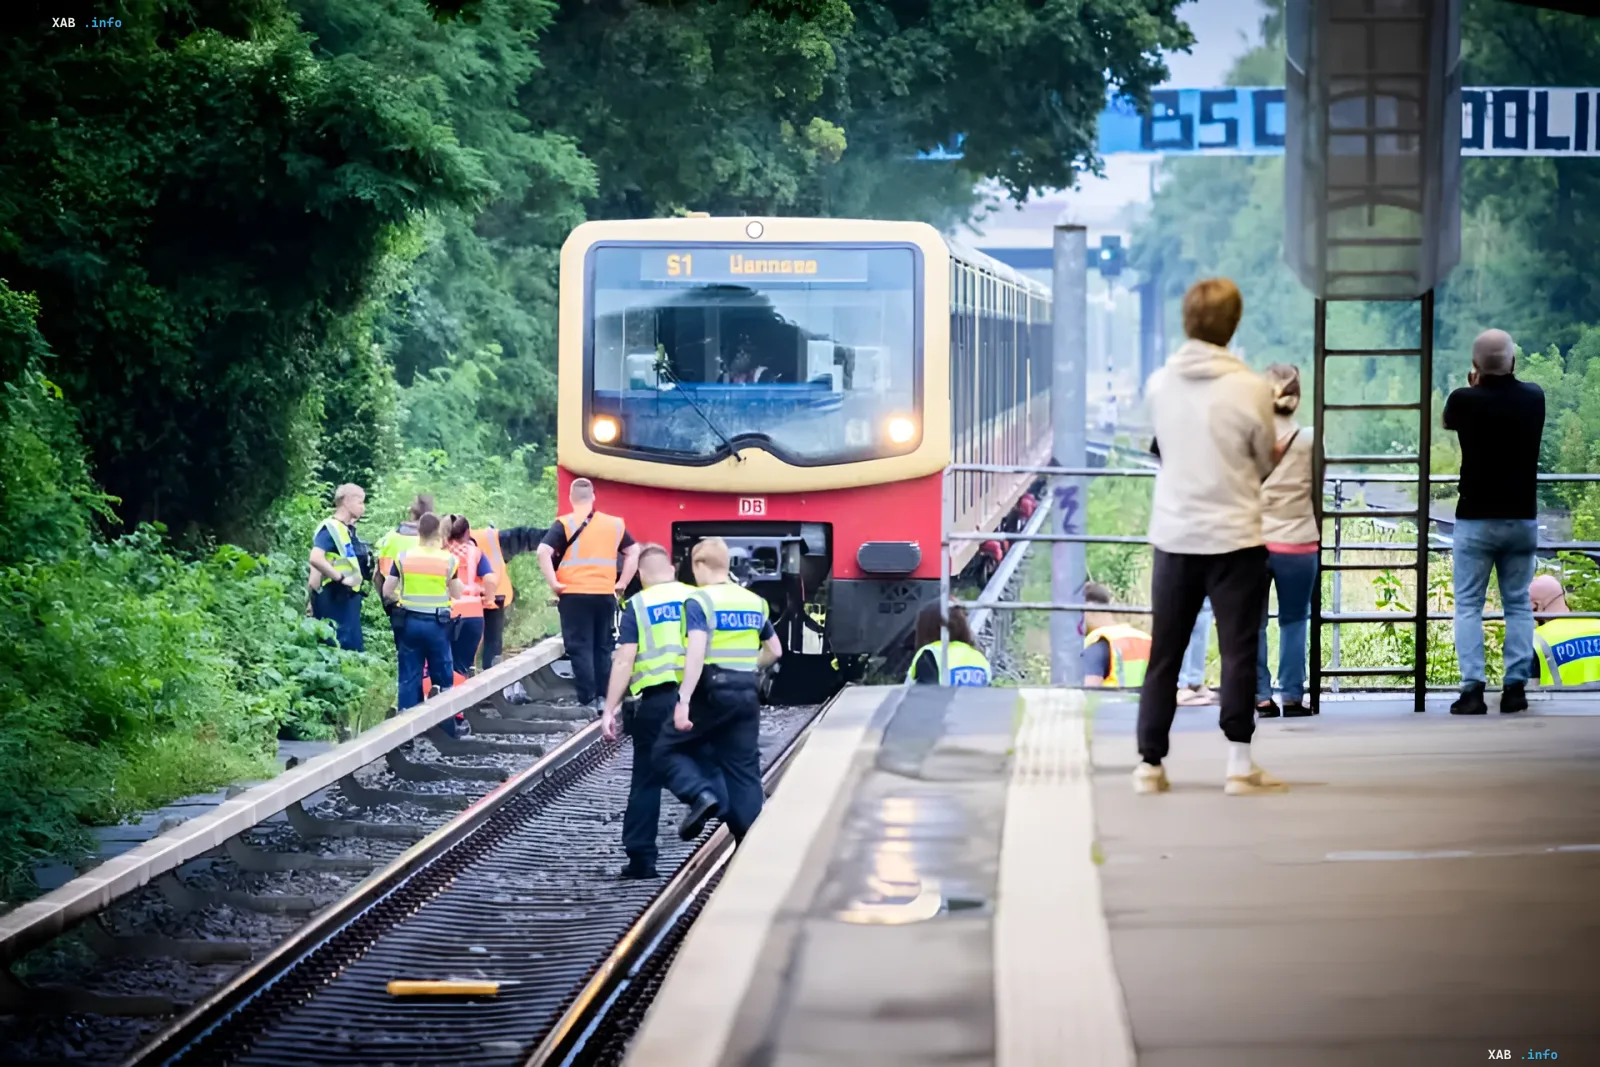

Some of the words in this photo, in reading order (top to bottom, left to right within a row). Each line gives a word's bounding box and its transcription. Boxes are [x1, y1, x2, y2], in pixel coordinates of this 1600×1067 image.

[667, 253, 692, 276] S1
[742, 500, 762, 513] DB
[653, 604, 681, 621] POL
